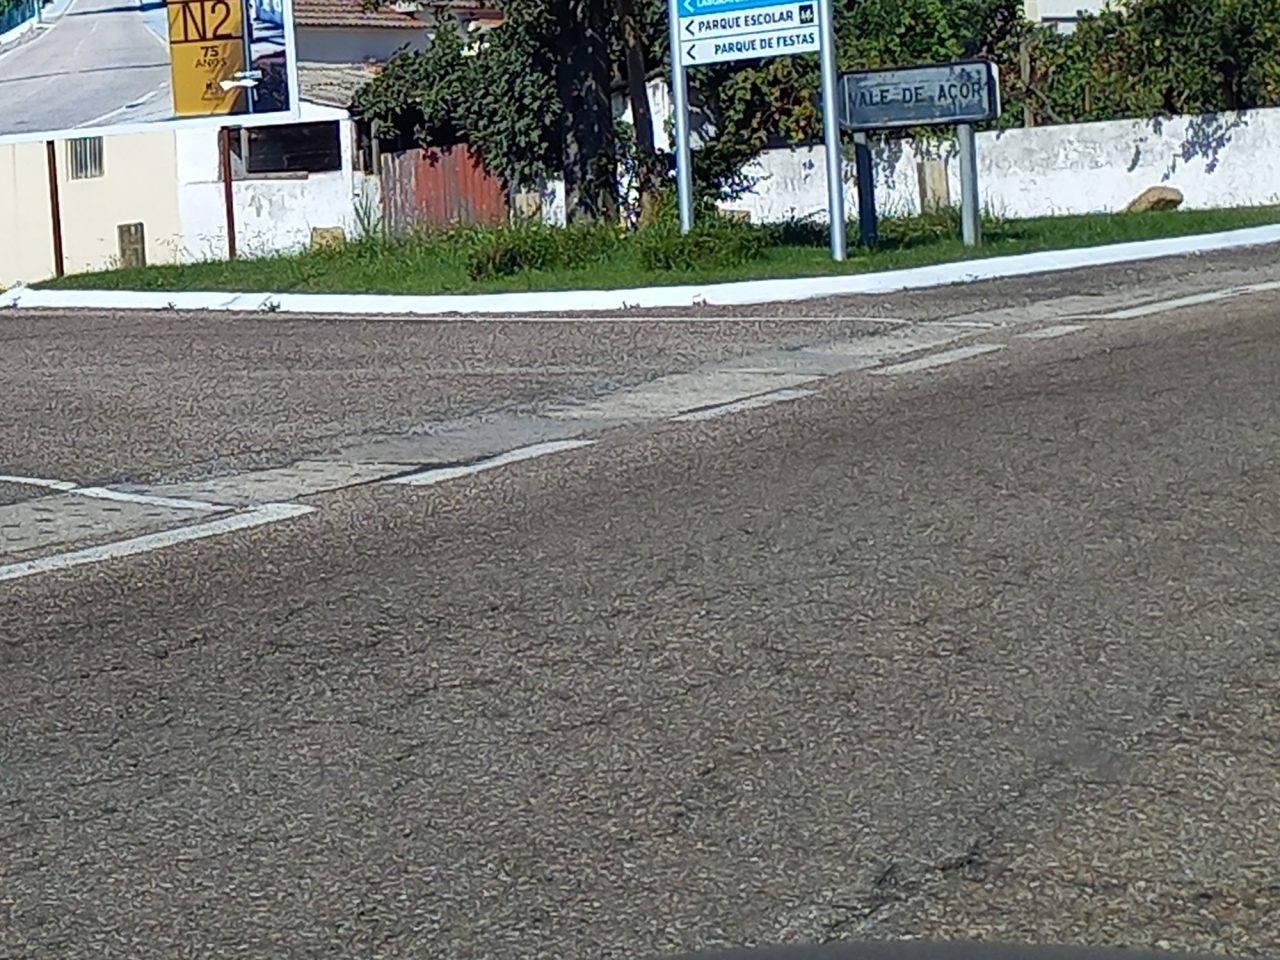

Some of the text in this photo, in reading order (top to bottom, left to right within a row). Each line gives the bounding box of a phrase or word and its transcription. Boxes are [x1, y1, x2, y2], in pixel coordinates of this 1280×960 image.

[182, 0, 233, 42] N2
[698, 10, 793, 32] PARQUE ESCOLAR
[200, 46, 219, 58] 75
[714, 32, 815, 55] PARQUE DE FESTAS
[849, 81, 983, 107] VALE DE AÇOR
